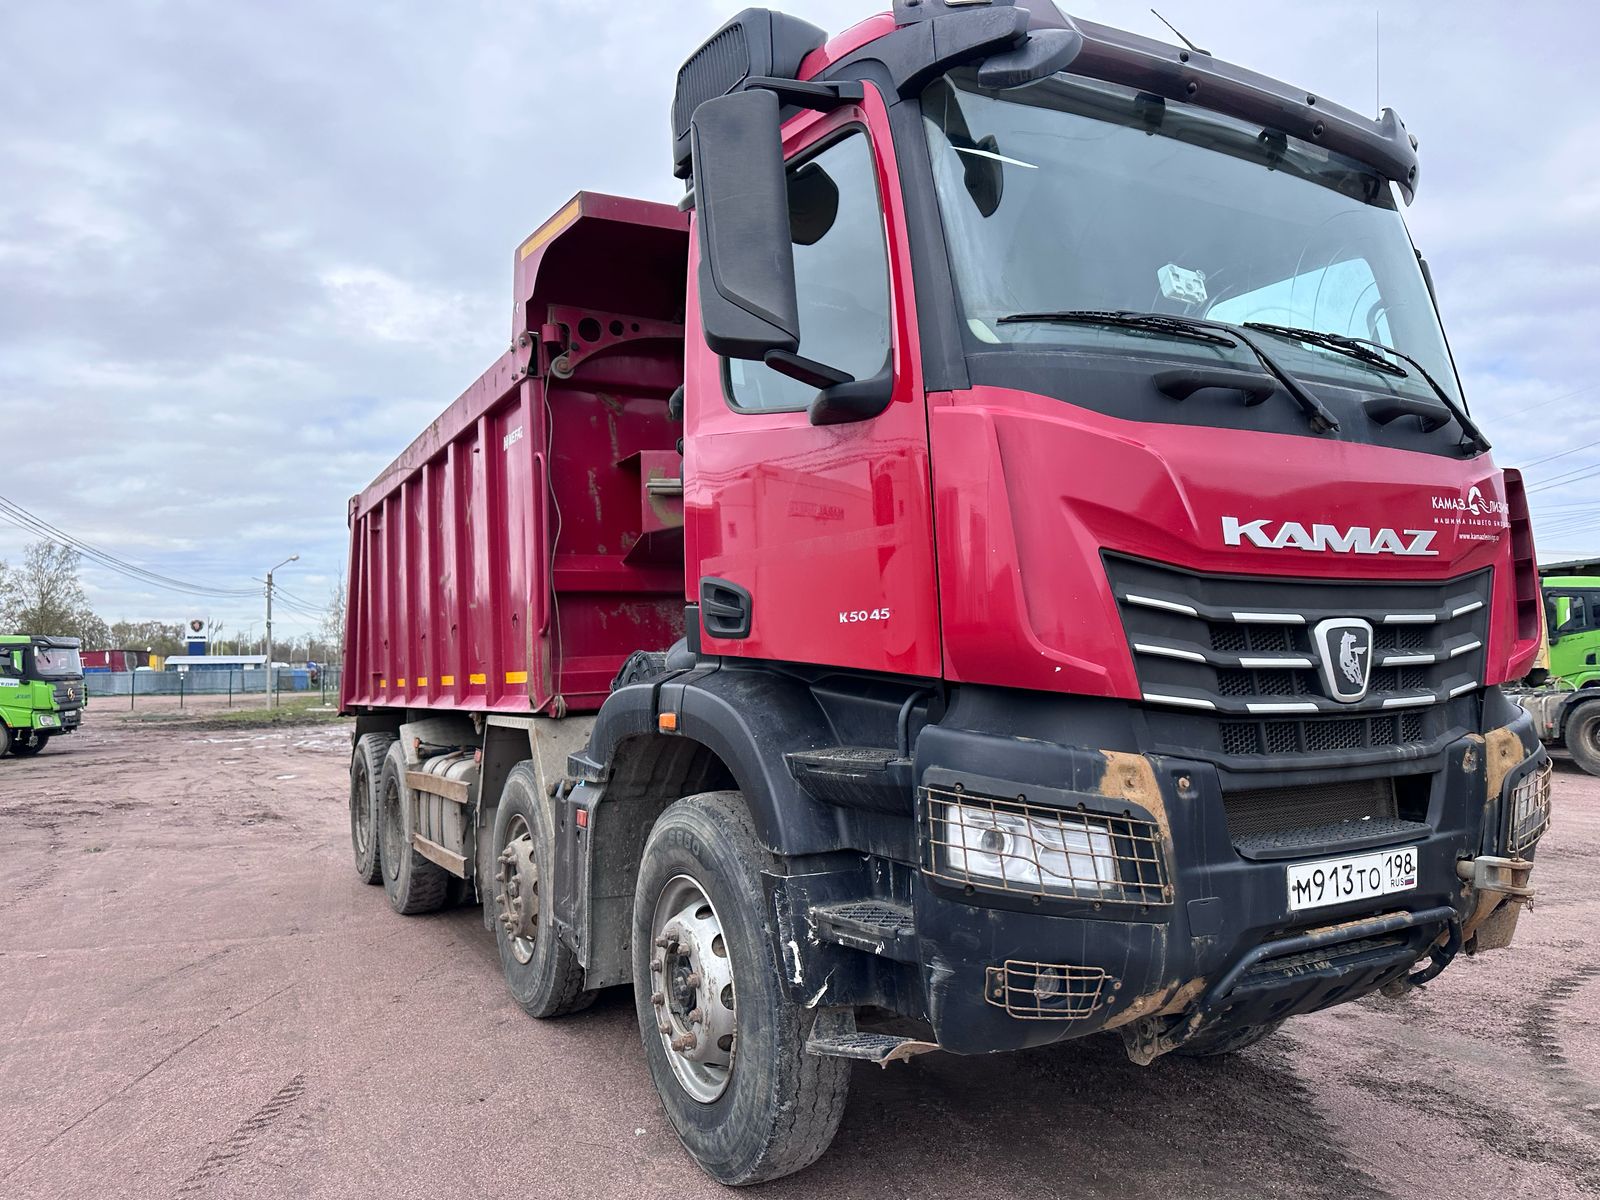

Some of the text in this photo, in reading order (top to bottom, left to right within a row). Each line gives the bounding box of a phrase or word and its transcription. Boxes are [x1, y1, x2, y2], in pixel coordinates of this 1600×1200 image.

[1431, 496, 1466, 511] КАМАЗ
[1221, 516, 1439, 556] KAMAZ
[839, 608, 890, 623] K5045
[1385, 853, 1412, 879] 198
[1390, 877, 1405, 888] RUS
